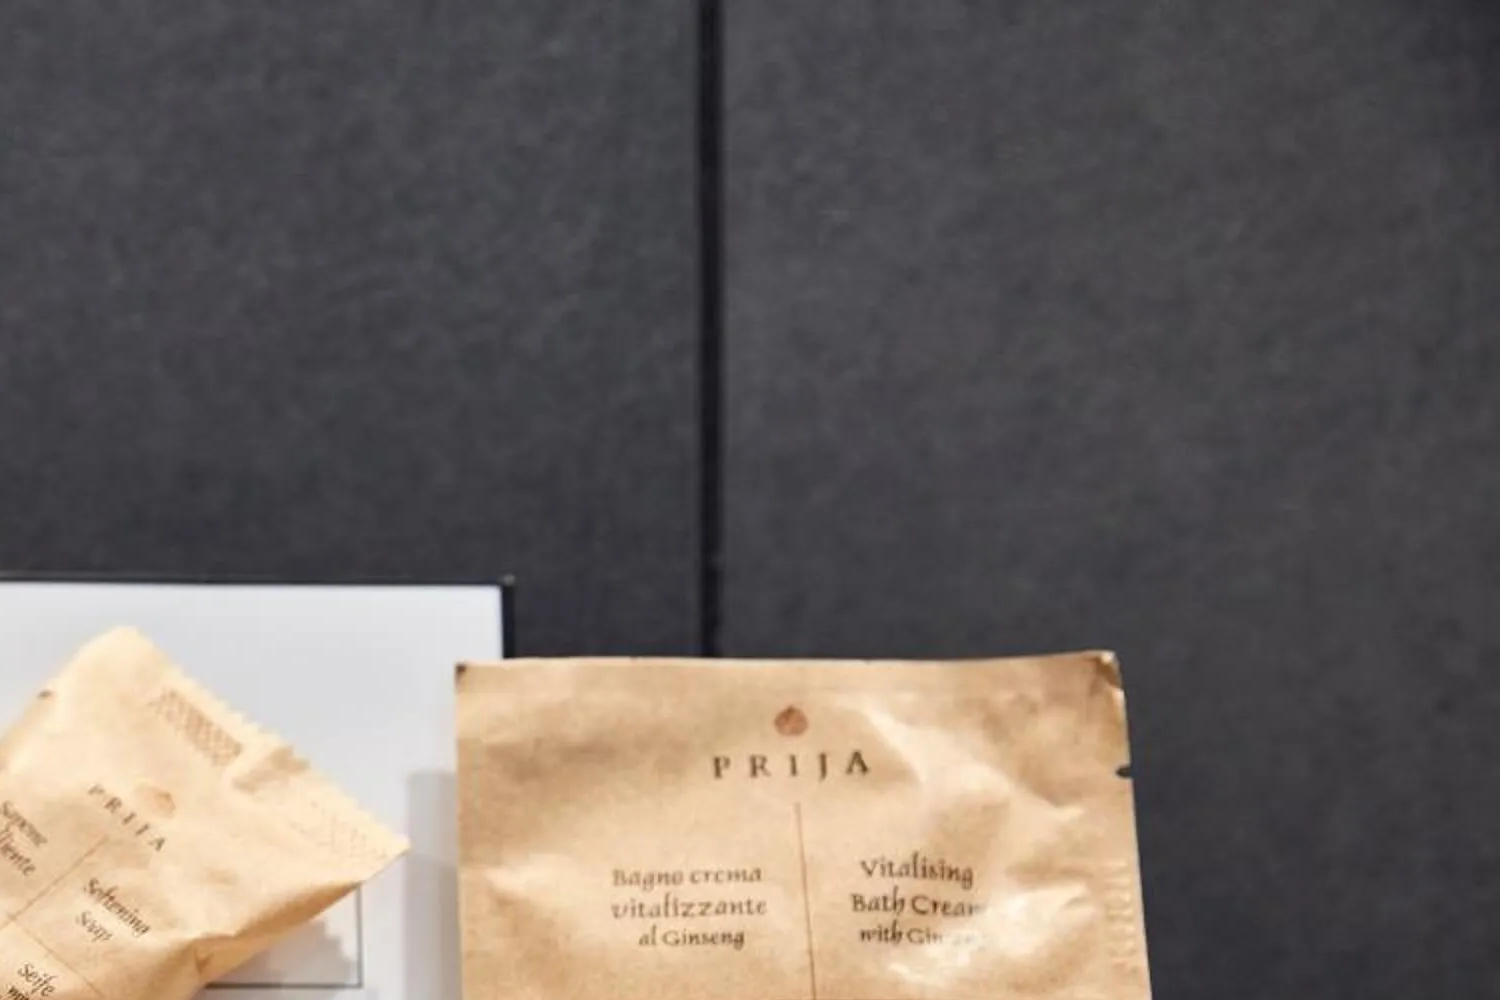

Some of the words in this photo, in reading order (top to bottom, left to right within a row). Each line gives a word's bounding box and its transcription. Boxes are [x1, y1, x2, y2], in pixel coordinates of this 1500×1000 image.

[710, 749, 873, 781] PRIJA
[87, 784, 167, 852] PRIJA
[611, 867, 685, 893] Bagno
[690, 865, 764, 886] crema
[859, 851, 975, 891] Vitalising
[82, 876, 151, 939] Softening
[610, 893, 769, 920] vitalizzante
[849, 884, 907, 918] Bath
[74, 909, 114, 944] Soap
[638, 925, 658, 948] al
[661, 926, 746, 952] Ginseng
[859, 918, 904, 945] with
[16, 962, 58, 998] Seife
